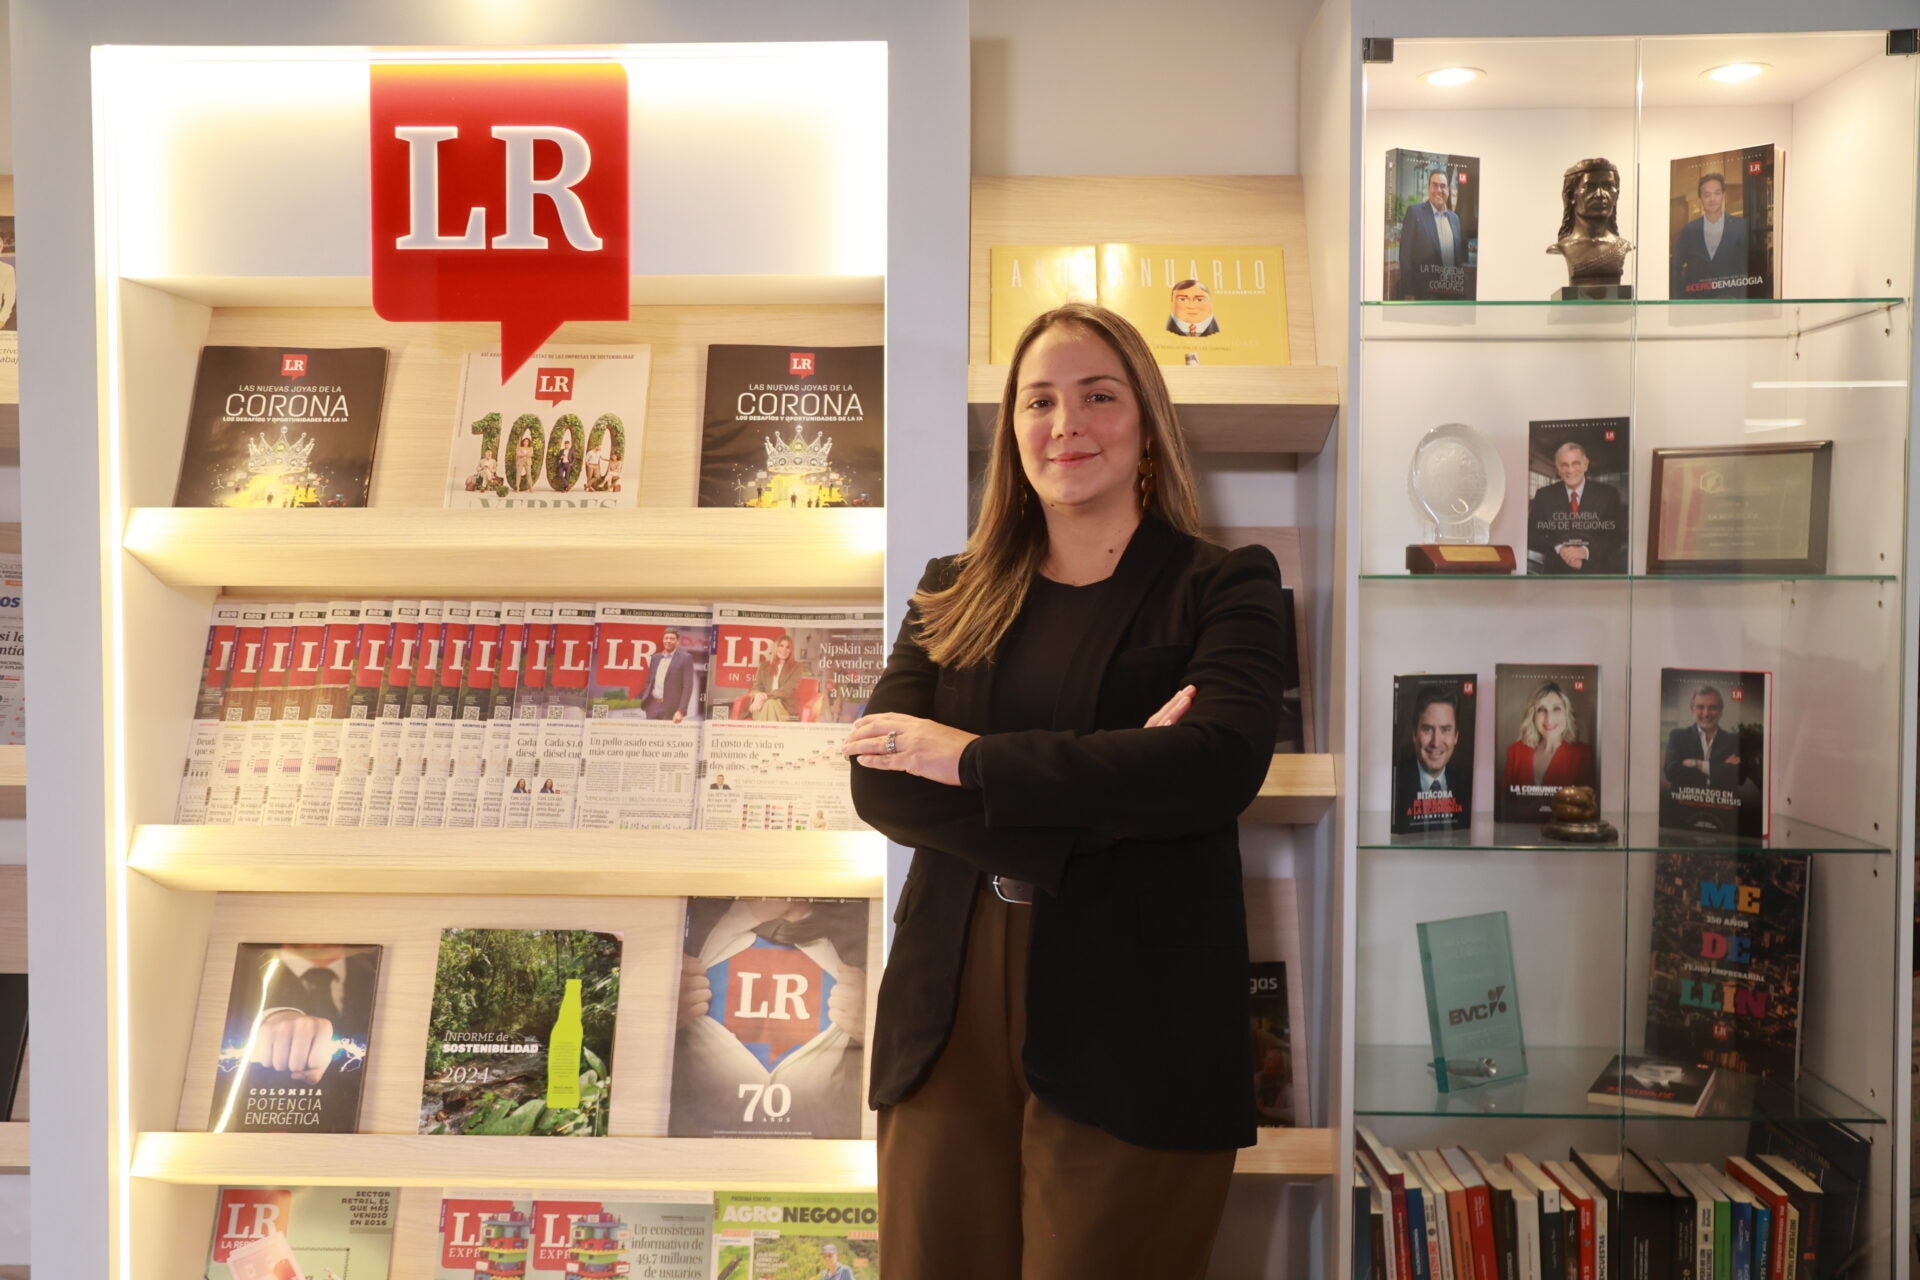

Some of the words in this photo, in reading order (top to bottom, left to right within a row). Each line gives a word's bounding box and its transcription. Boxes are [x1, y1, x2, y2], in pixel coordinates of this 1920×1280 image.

[1750, 164, 1760, 172] LR
[395, 126, 603, 251] LR
[1106, 258, 1266, 289] NUARIO
[284, 360, 304, 370] LR
[792, 358, 812, 370] LR
[539, 376, 569, 392] LR
[225, 394, 349, 417] CORONA
[737, 392, 864, 416] CORONA
[472, 412, 626, 492] 1000
[1558, 521, 1569, 530] DE
[1572, 521, 1616, 530] REGIONES
[330, 640, 353, 670] L
[604, 638, 656, 671] LR
[819, 643, 861, 656] Nipskin
[864, 642, 884, 654] salt
[297, 642, 318, 671] L
[819, 657, 832, 668] de
[836, 657, 873, 669] vender
[830, 690, 837, 698] a
[840, 686, 871, 698] Walm
[518, 738, 537, 747] Cada
[544, 738, 565, 747] Cada
[590, 738, 600, 746] Un
[602, 738, 621, 747] pollo
[624, 738, 646, 747] asado
[648, 738, 664, 747] está
[711, 739, 718, 748] El
[720, 740, 741, 748] costo
[743, 740, 754, 748] de
[755, 740, 773, 749] vida
[544, 748, 566, 759] diésel
[568, 751, 581, 759] cue
[589, 748, 605, 756] más
[626, 750, 640, 758] que
[642, 749, 660, 758] hace
[674, 750, 688, 758] año
[710, 750, 747, 759] máximos
[749, 751, 759, 759] de
[709, 761, 724, 770] dos
[726, 762, 745, 770] años
[1679, 787, 1721, 796] LIDERAZGO
[1672, 792, 1704, 802] TIEMPOS
[1717, 797, 1741, 806] CRISIS
[1700, 880, 1761, 914] ME
[1724, 917, 1749, 928] AÑOS
[1701, 931, 1750, 964] DE
[1712, 967, 1765, 982] EMPRESARIAL
[1250, 977, 1278, 994] gas
[734, 971, 810, 1020] LR
[1680, 978, 1769, 1019] LLIN
[1448, 1004, 1488, 1026] BVC
[444, 1030, 494, 1042] INFORME
[496, 1032, 508, 1042] de
[442, 1044, 539, 1054] SOSTENIBILIDAD
[441, 1067, 489, 1084] 2024
[250, 1088, 322, 1096] COLOMBIA
[247, 1098, 322, 1110] POTENCIA
[738, 1083, 791, 1122] 70
[245, 1108, 320, 1125] ENERGÉTICA
[223, 1203, 280, 1239] LR
[353, 1211, 388, 1219] VENDIÓ
[722, 1206, 878, 1224] AGRONEGOCIO
[634, 1224, 647, 1235] Un
[650, 1224, 704, 1236] ecosistema
[631, 1237, 688, 1250] informativo
[690, 1239, 703, 1250] de
[449, 1248, 481, 1258] EXPR
[539, 1249, 570, 1259] EXPR
[660, 1253, 703, 1265] millones
[644, 1267, 656, 1279] de
[659, 1267, 702, 1279] usuarios
